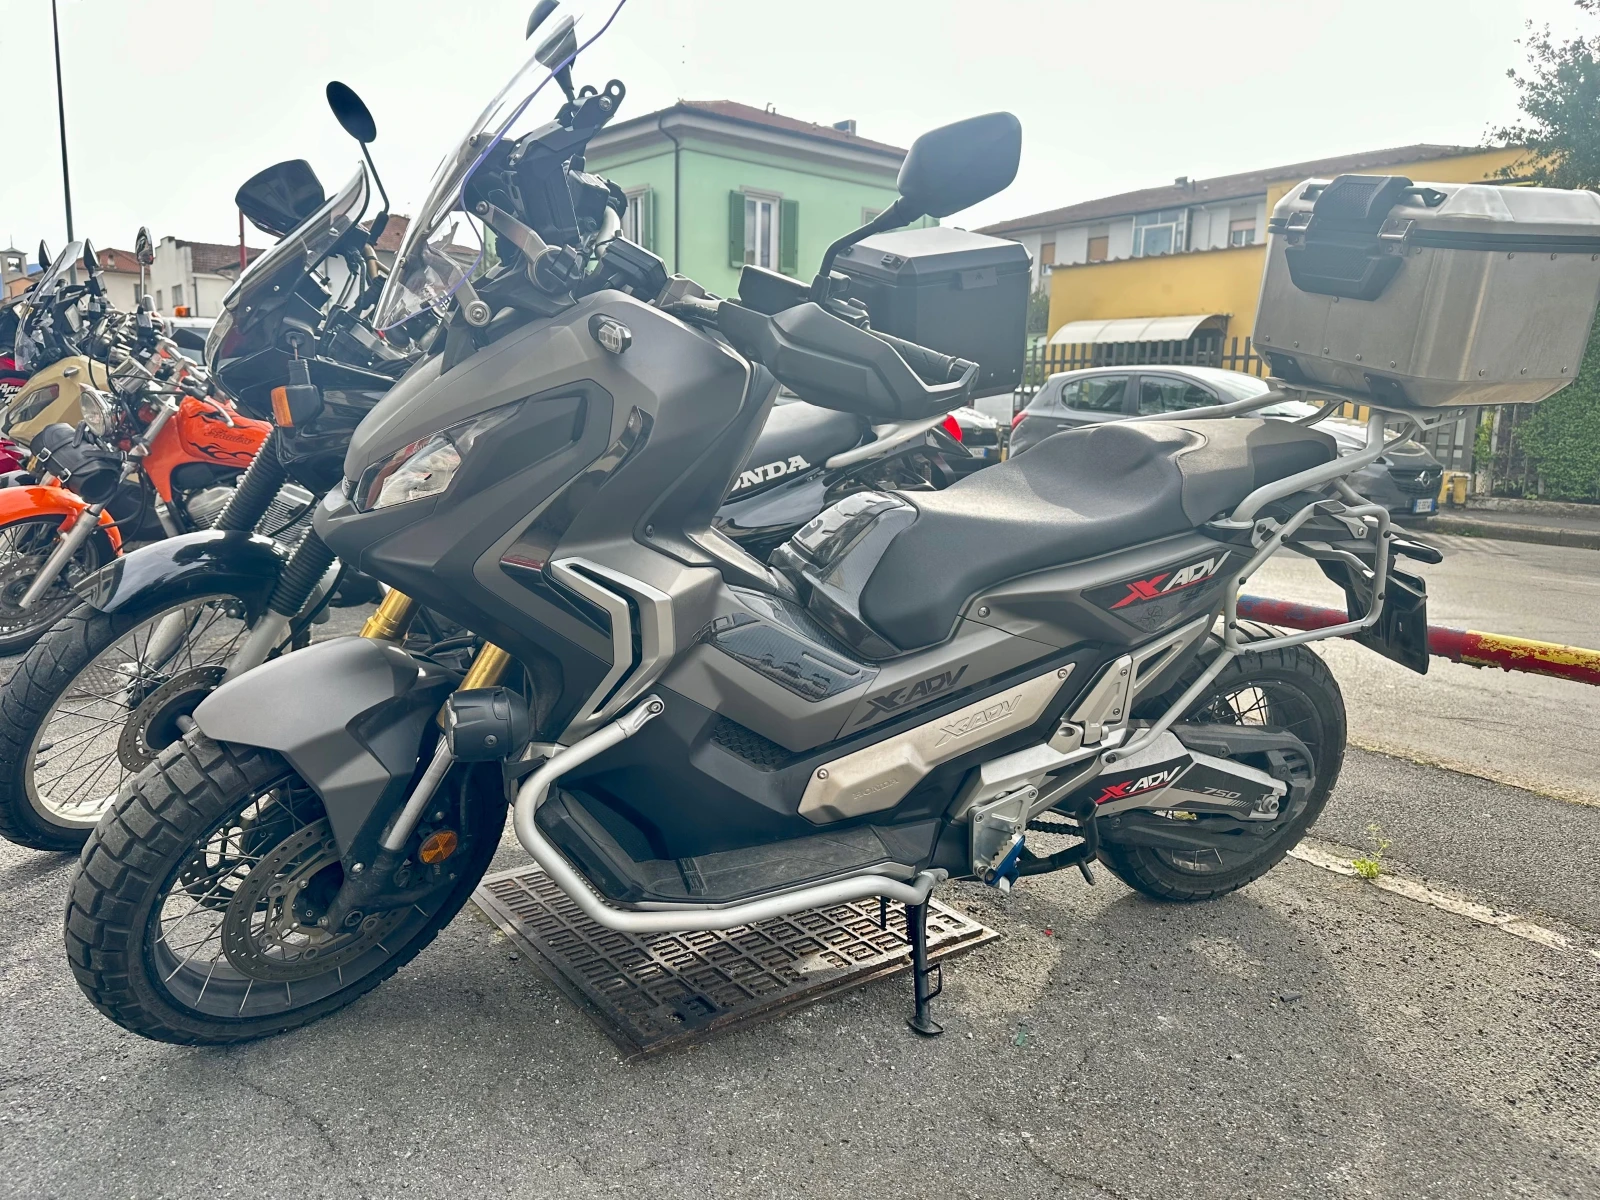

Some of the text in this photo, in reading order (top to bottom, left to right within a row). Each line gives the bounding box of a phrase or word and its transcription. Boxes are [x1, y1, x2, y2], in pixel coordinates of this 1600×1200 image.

[853, 664, 969, 726] X-ADV
[1095, 766, 1181, 805] X-ADV
[1202, 787, 1242, 799] 750
